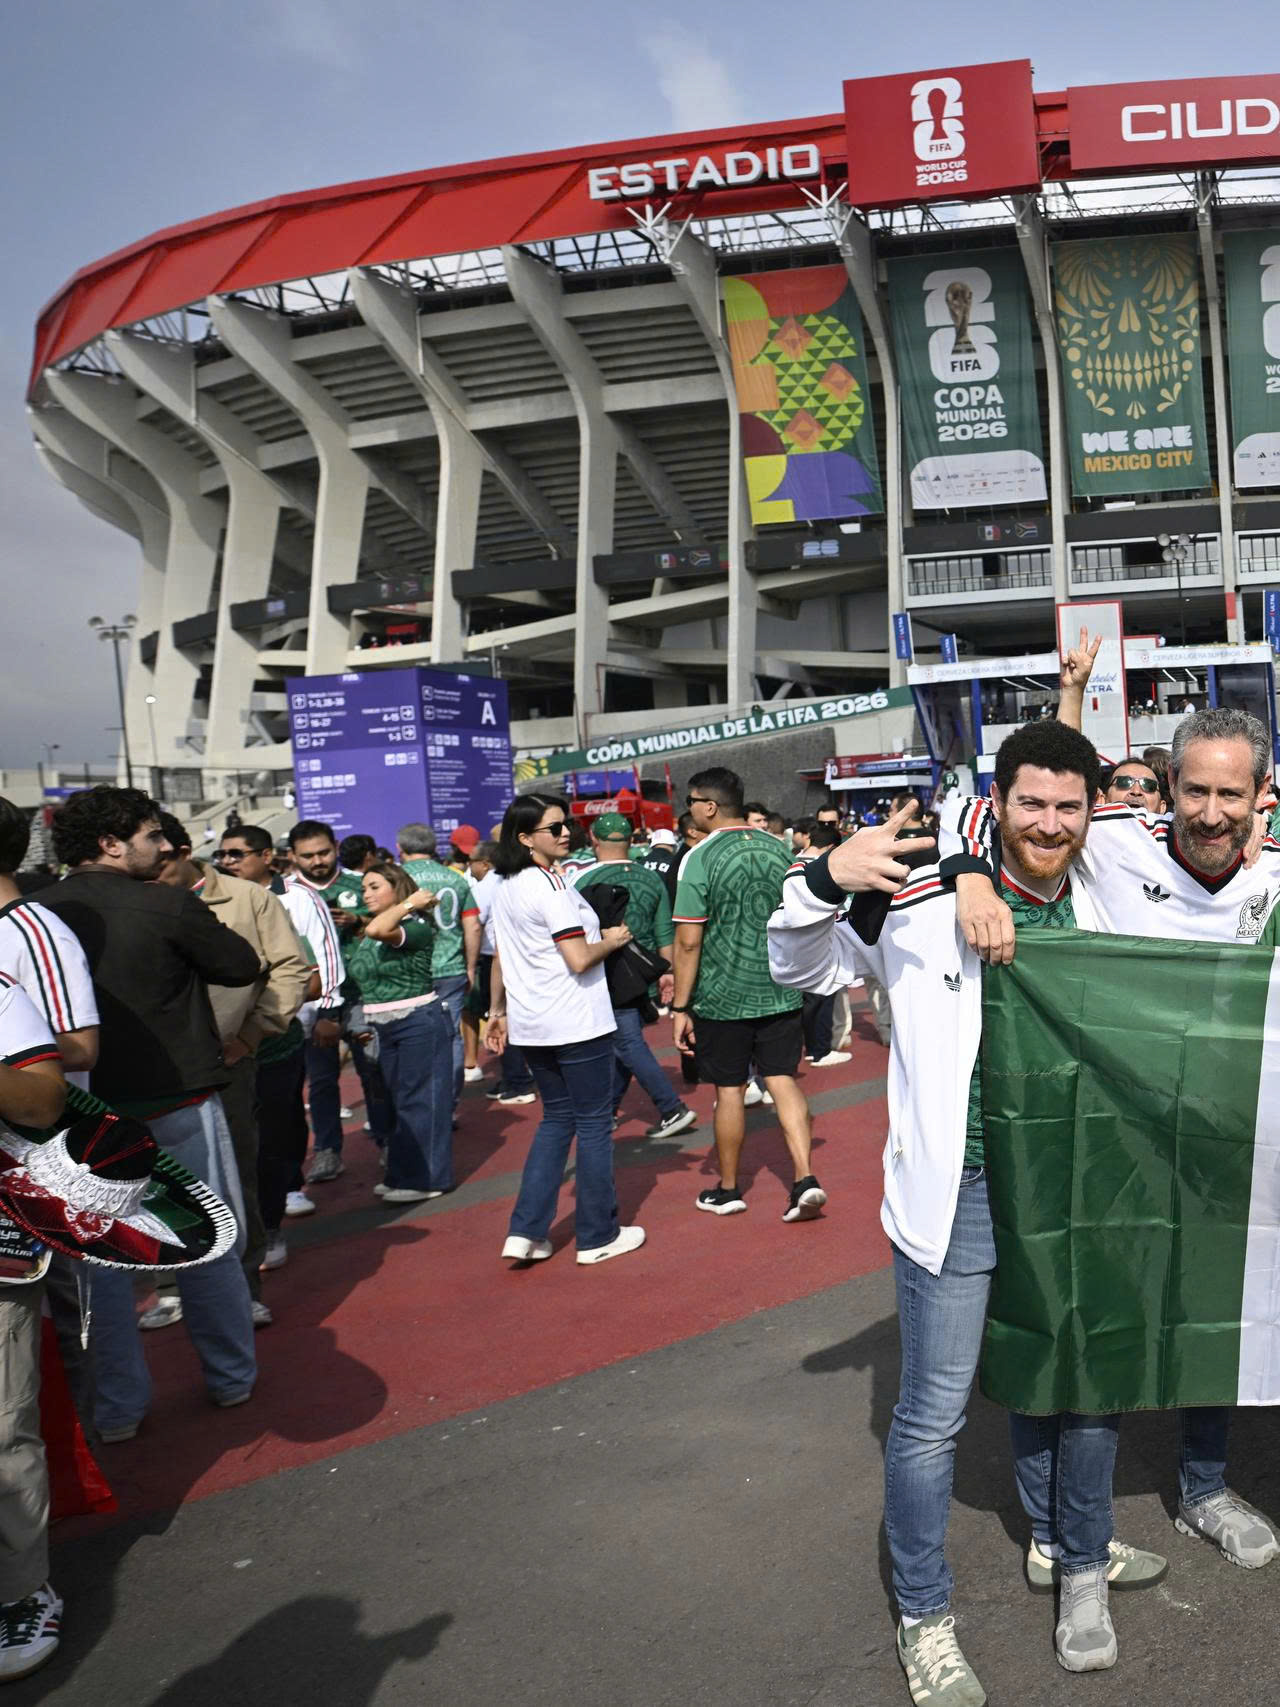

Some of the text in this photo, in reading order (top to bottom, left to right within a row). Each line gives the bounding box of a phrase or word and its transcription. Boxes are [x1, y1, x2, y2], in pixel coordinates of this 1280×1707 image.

[929, 143, 952, 153] FIFA
[588, 143, 820, 200] ESTADIO
[916, 160, 968, 173] WORLD CUP
[916, 169, 968, 186] 2026
[951, 360, 982, 372] FIFA
[934, 385, 1004, 409] COPA
[936, 407, 1006, 423] MUNDIAL
[938, 421, 1008, 442] 2026
[1082, 430, 1130, 453] WE
[1084, 450, 1192, 472] MEXICO CITY
[1085, 684, 1113, 693] LTRA
[481, 701, 496, 725] A
[586, 692, 888, 765] COPA MUNDIAL DE LA FIFA 2026
